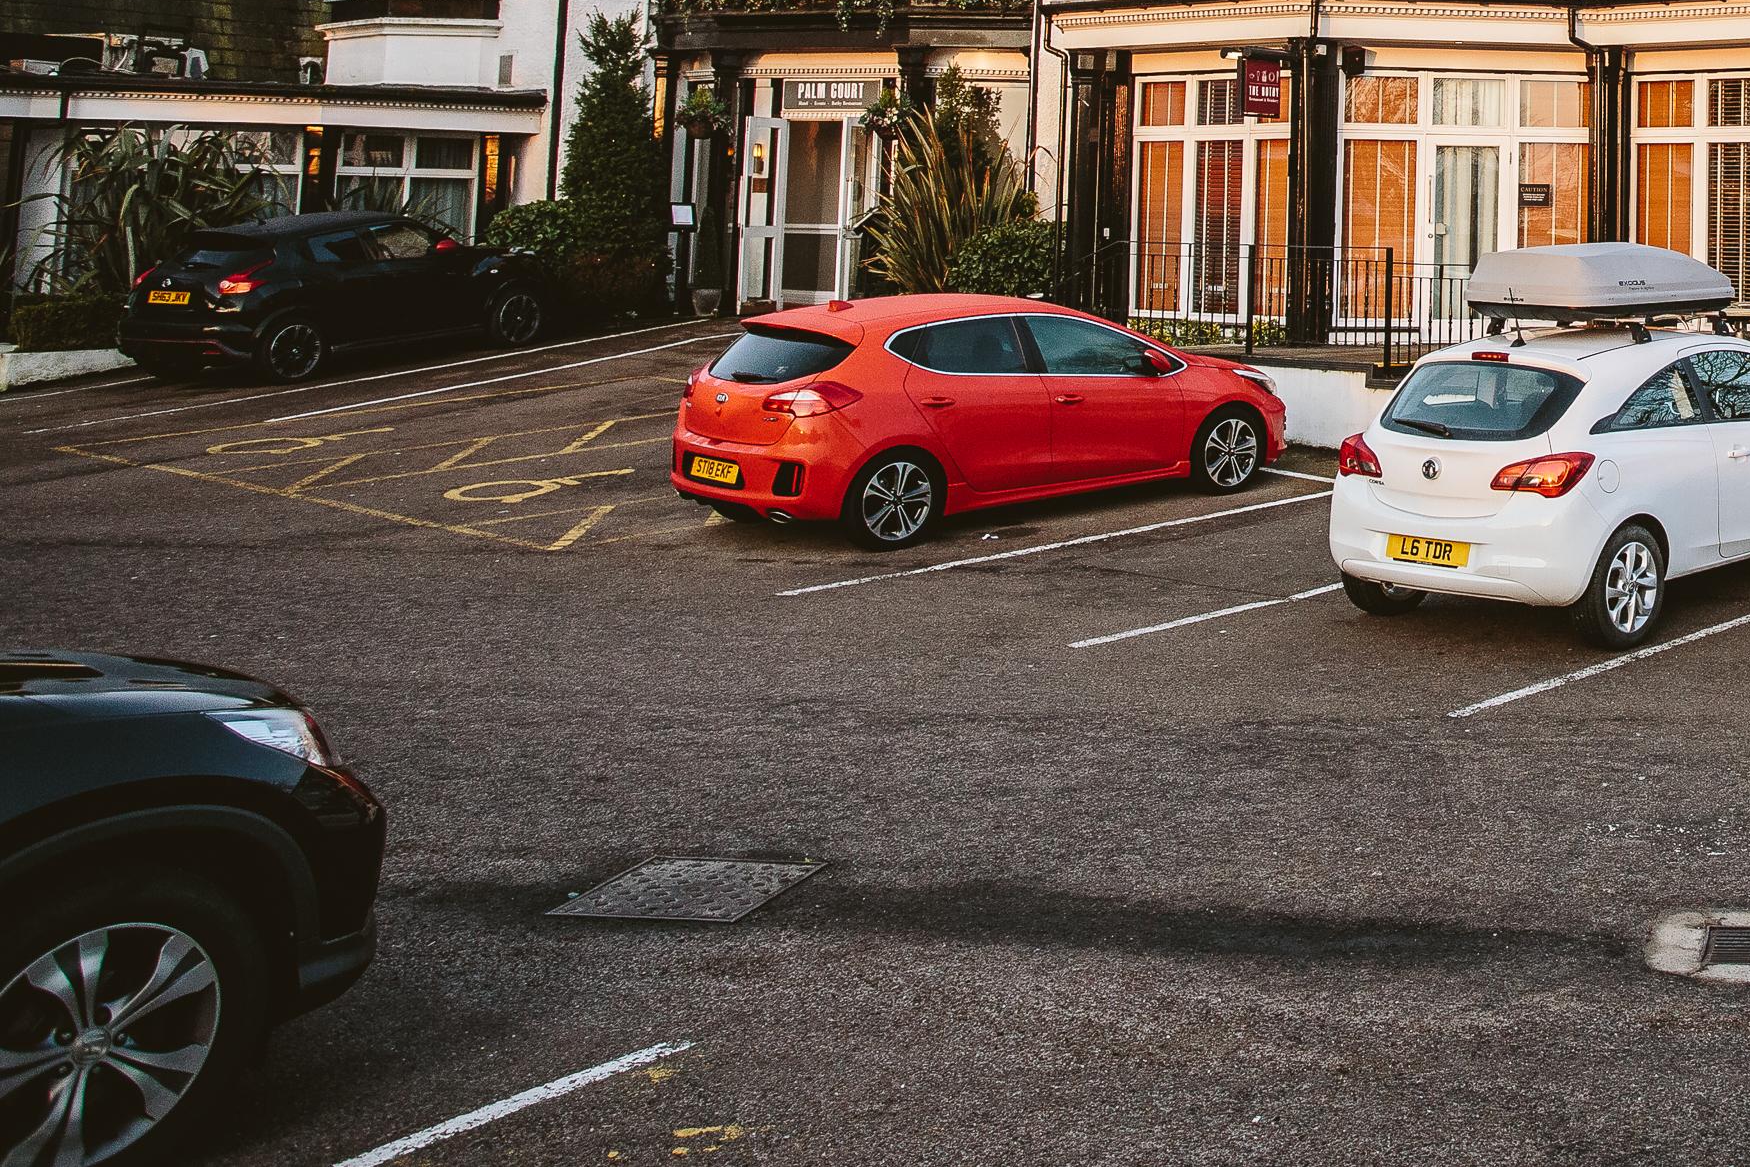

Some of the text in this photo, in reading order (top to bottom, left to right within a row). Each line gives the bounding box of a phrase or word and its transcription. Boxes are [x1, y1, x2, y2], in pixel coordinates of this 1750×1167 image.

[798, 82, 864, 99] PALM COURT
[1249, 85, 1258, 96] THE
[697, 459, 733, 479] ST18 EKF
[1401, 537, 1453, 561] L6 TDR
